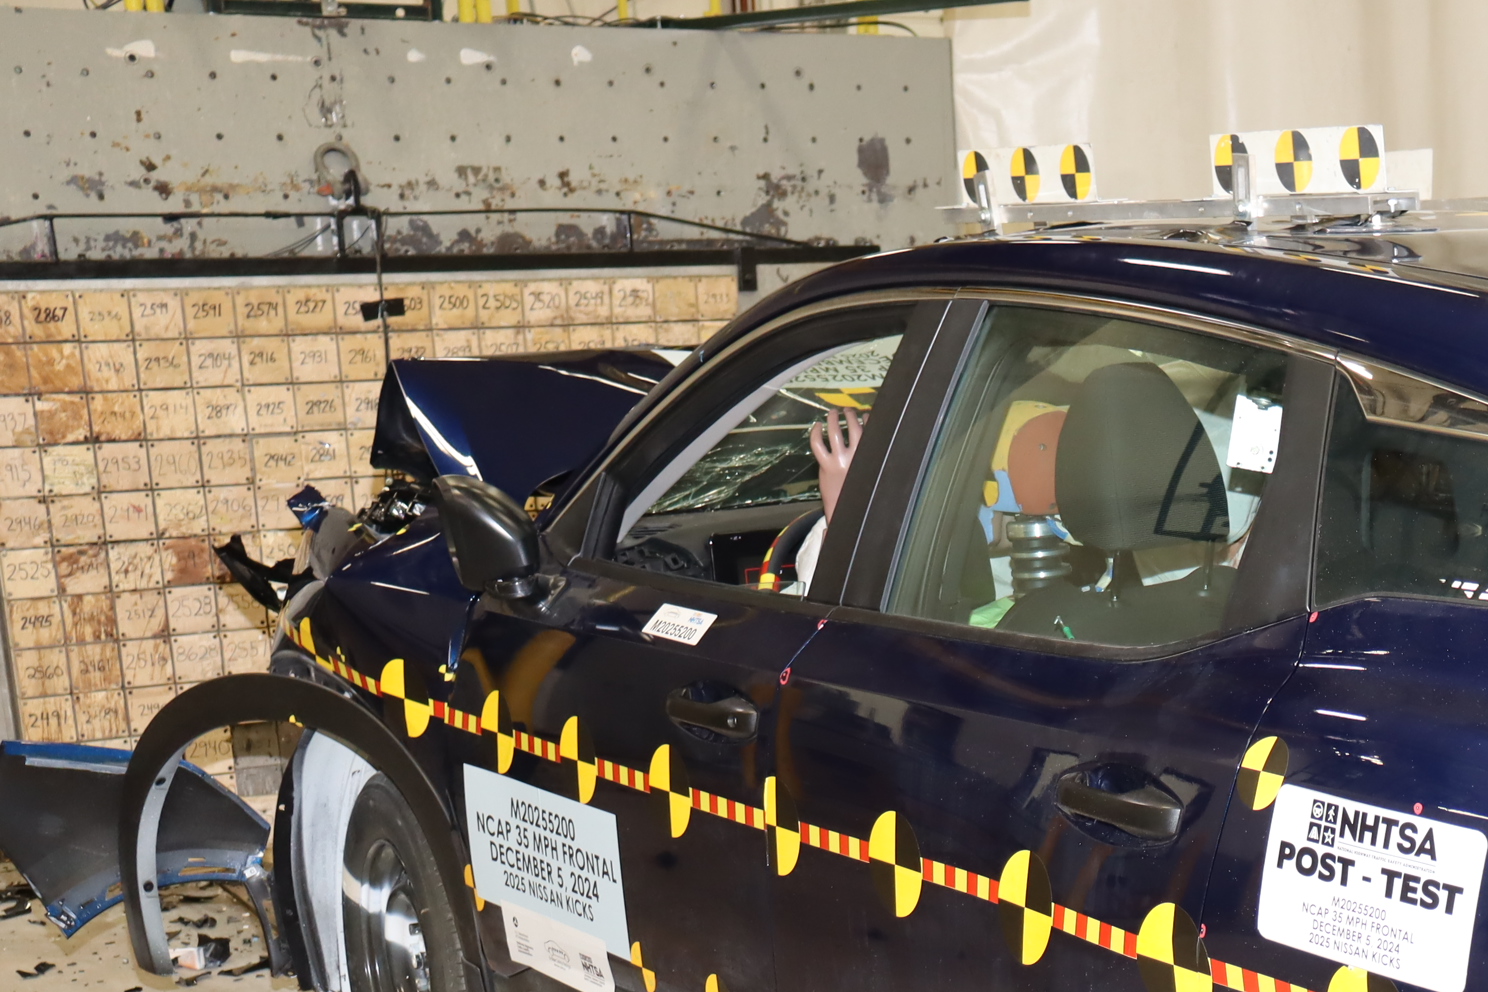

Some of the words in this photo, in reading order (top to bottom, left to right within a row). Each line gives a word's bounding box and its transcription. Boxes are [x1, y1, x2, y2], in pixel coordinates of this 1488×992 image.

[33, 306, 68, 324] 2867
[191, 302, 222, 319] 2591
[438, 295, 470, 311] 2500
[248, 351, 276, 366] 2916
[6, 561, 52, 581] 2525
[650, 619, 697, 641] M20255200
[28, 709, 67, 728] 2491
[510, 797, 576, 841] M20255200
[1338, 806, 1437, 861] NHTSA
[476, 811, 511, 841] NCAP
[515, 824, 530, 849] 35
[533, 831, 559, 861] MPH
[562, 842, 618, 884] FRONTAL
[489, 840, 554, 885] DECEMBER
[557, 866, 568, 892] 5,
[570, 871, 600, 903] 2024
[1277, 840, 1356, 887] POST
[1380, 867, 1465, 915] TEST
[503, 870, 526, 894] 2025
[528, 879, 564, 910] NISSAN
[565, 895, 594, 922] KICKS
[1331, 896, 1387, 921] M20255200
[1302, 901, 1330, 919] NCAP
[1331, 910, 1343, 923] 35
[1346, 914, 1368, 931] MPH
[1370, 921, 1414, 944] FRONTAL
[1312, 919, 1363, 944] DECEMBER
[1376, 938, 1400, 954] 2024
[1309, 932, 1331, 949] 2025
[1333, 940, 1369, 960] NISSAN
[1371, 951, 1401, 970] KICKS
